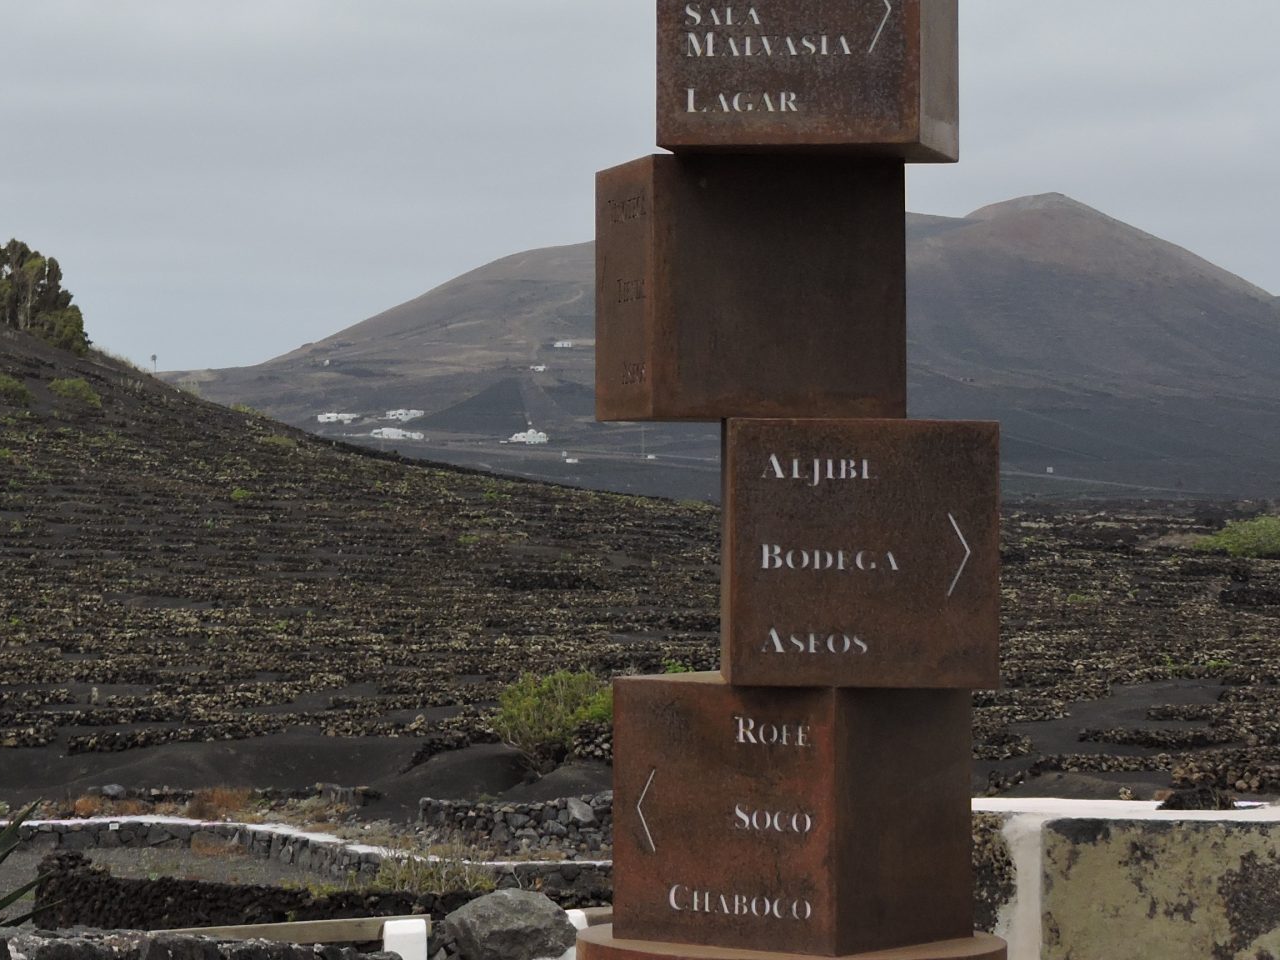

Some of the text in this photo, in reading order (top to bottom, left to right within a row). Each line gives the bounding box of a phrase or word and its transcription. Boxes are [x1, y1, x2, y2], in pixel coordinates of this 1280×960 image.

[684, 3, 761, 26] SALA
[686, 31, 852, 57] MALVASIA
[686, 88, 798, 113] LAGAR
[761, 543, 899, 571] BODEGA
[734, 804, 812, 834] SOCO
[669, 884, 811, 920] CHABOCO
